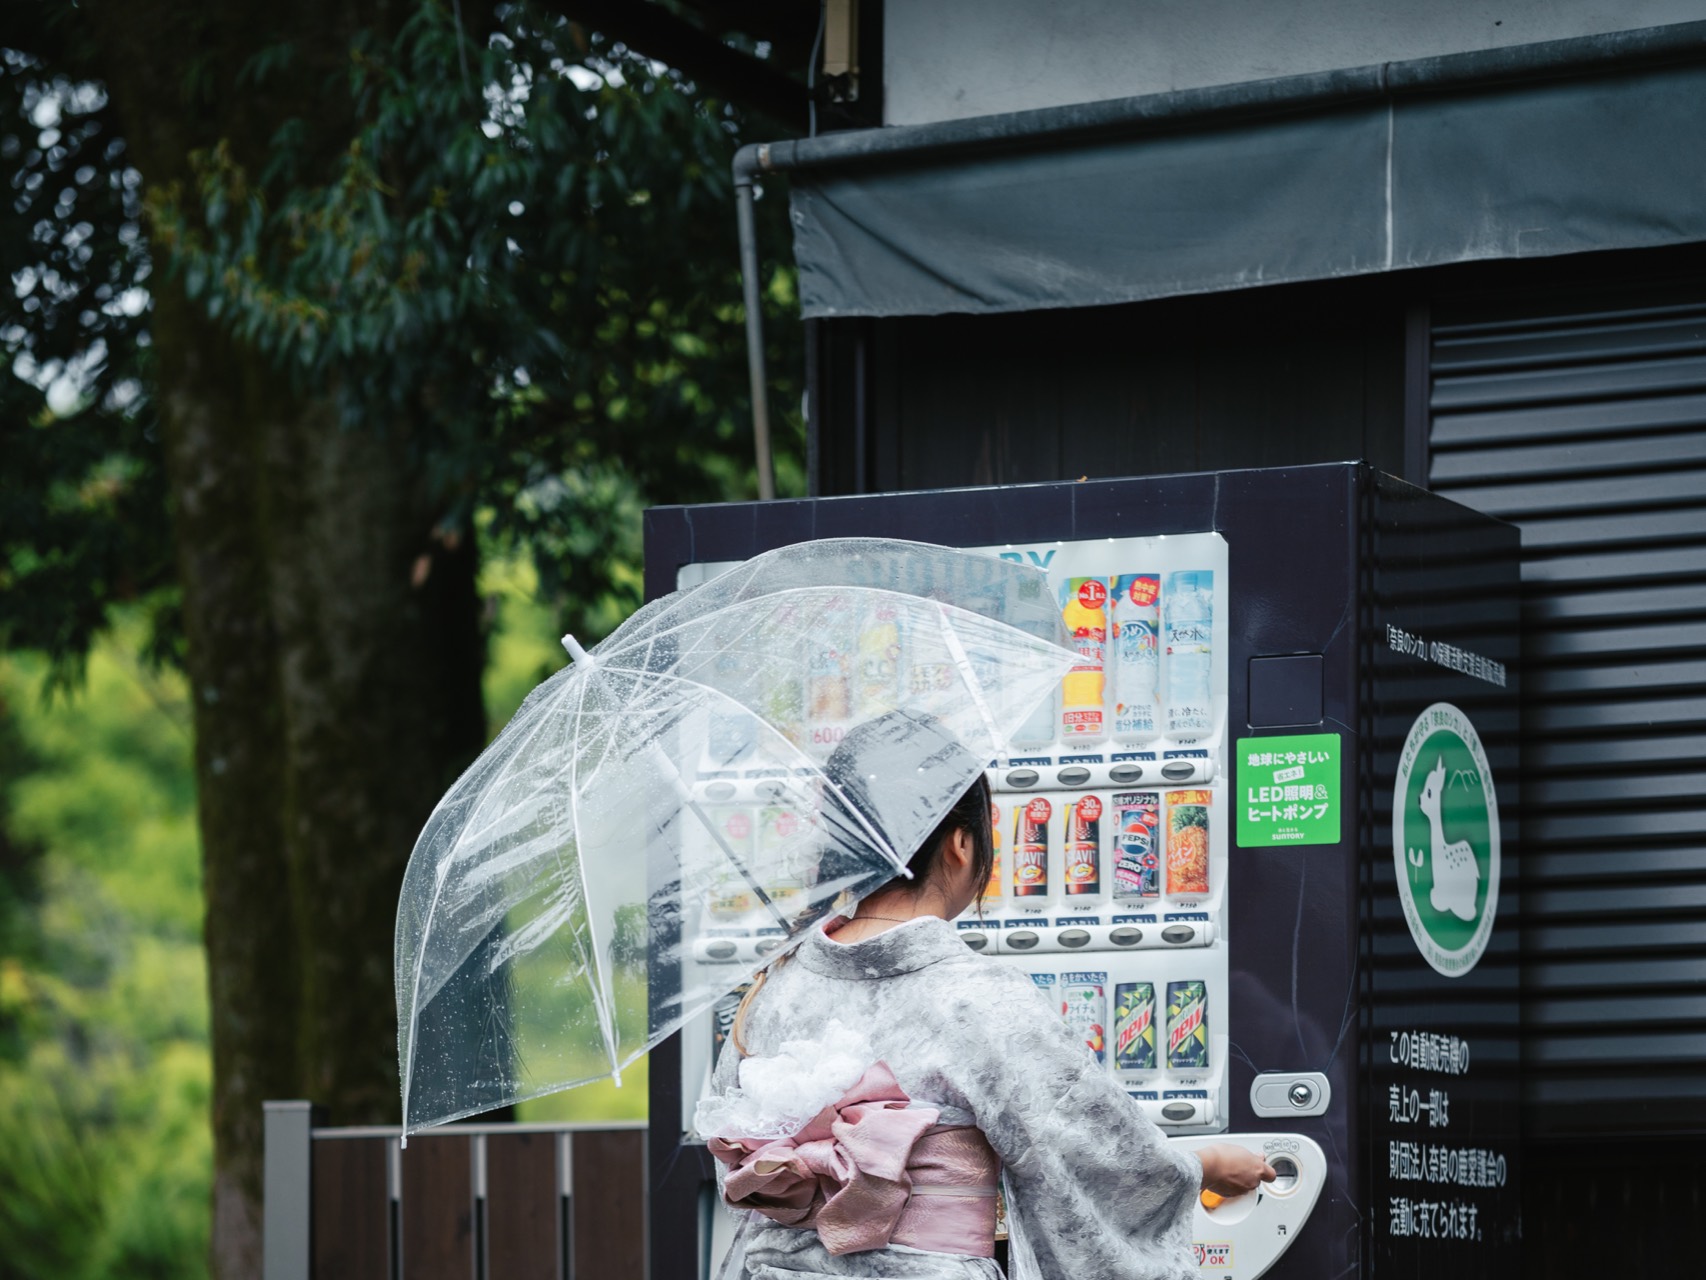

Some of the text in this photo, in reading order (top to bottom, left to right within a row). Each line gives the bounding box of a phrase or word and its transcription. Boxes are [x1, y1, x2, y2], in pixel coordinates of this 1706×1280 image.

[1248, 751, 1330, 767] 地球にやさしい
[1248, 784, 1328, 803] LED照明&
[1248, 803, 1329, 822] ヒートポンプ
[1122, 834, 1149, 847] PEPSI
[1117, 859, 1142, 873] ZERO
[1390, 1029, 1470, 1075] この自動販売機の
[1389, 1083, 1449, 1127] 売上の一部は
[1389, 1140, 1507, 1188] 財団法人奈良の鹿愛護会の
[1389, 1197, 1481, 1242] 活動に充てられます。
[1210, 1256, 1225, 1265] OK
